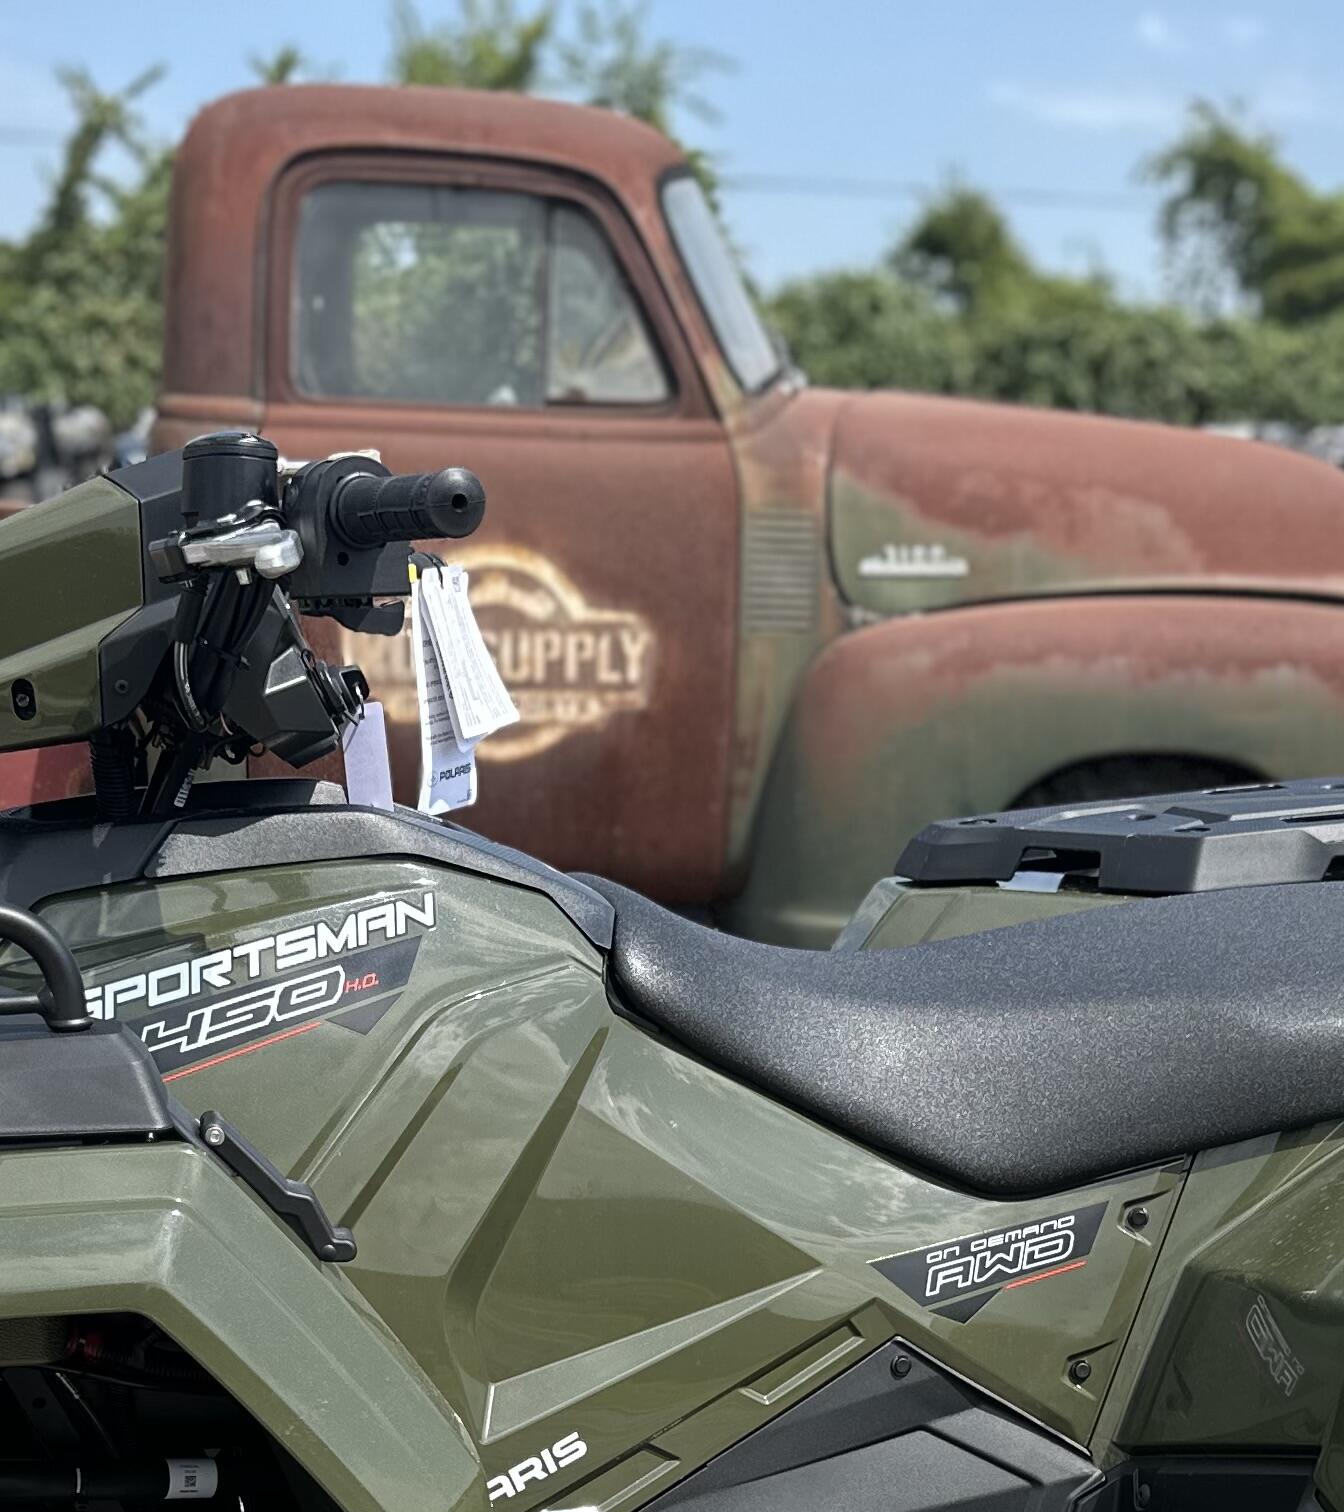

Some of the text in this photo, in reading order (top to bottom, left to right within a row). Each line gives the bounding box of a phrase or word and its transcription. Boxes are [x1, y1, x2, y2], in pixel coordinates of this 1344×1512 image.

[440, 763, 471, 782] POLARIS
[84, 893, 435, 1021] SPORTSMAN
[142, 965, 345, 1053] 450
[925, 1229, 1075, 1297] AWD
[926, 1215, 1075, 1264] ON DEMAND
